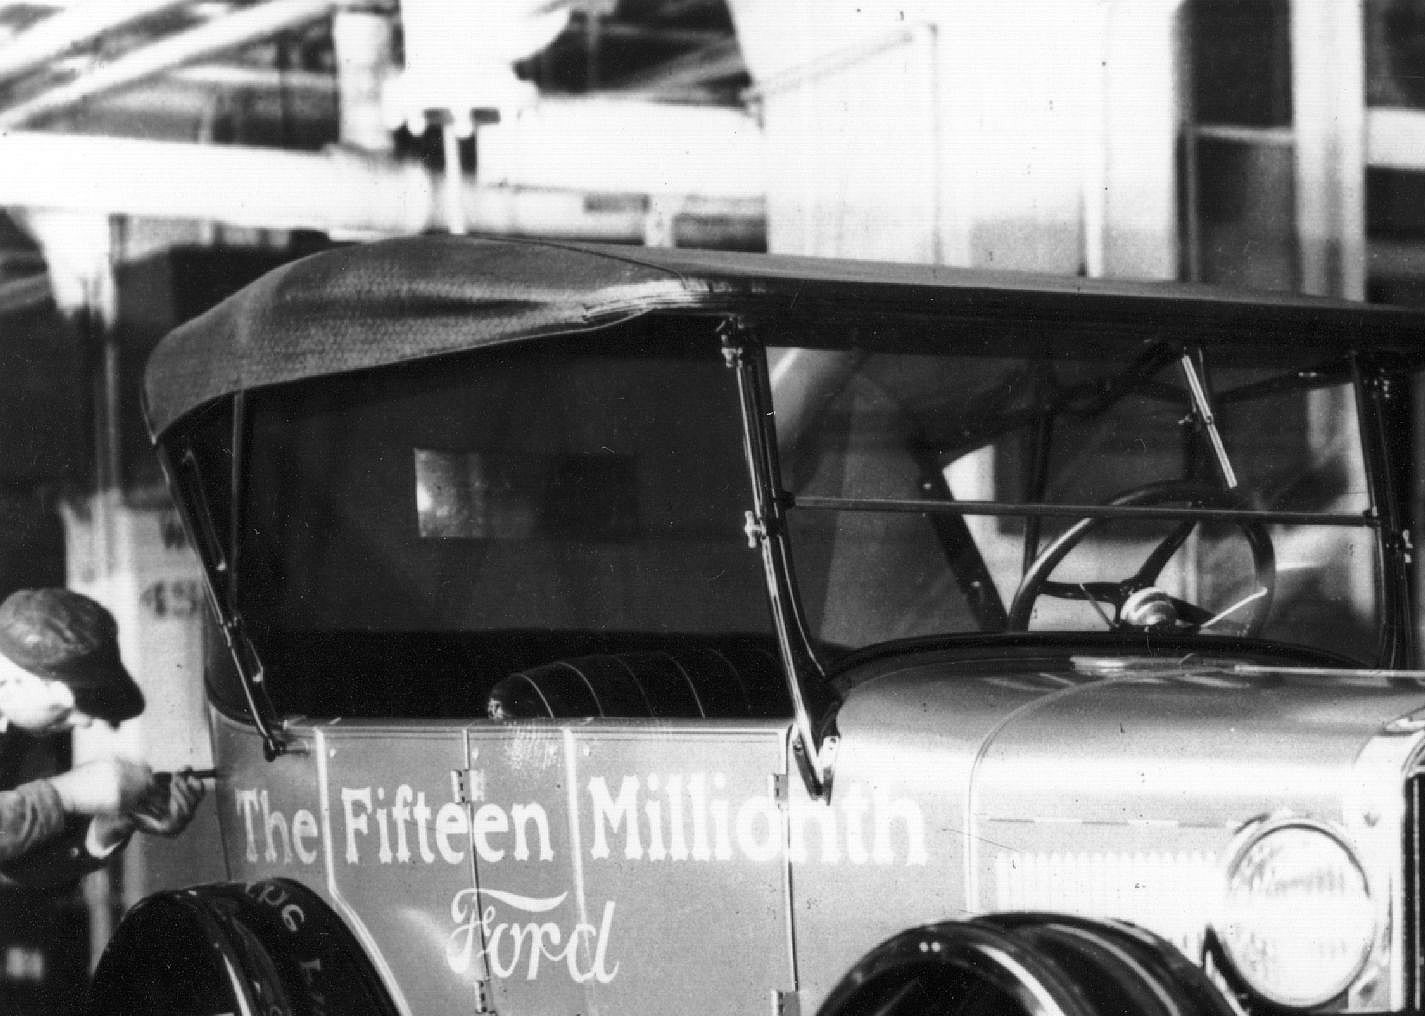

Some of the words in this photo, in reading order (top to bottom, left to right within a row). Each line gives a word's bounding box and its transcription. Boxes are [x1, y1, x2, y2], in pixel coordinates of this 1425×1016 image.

[235, 787, 318, 865] The
[341, 784, 554, 865] Fifteen
[588, 771, 928, 866] Millionth
[447, 887, 620, 984] Ford
